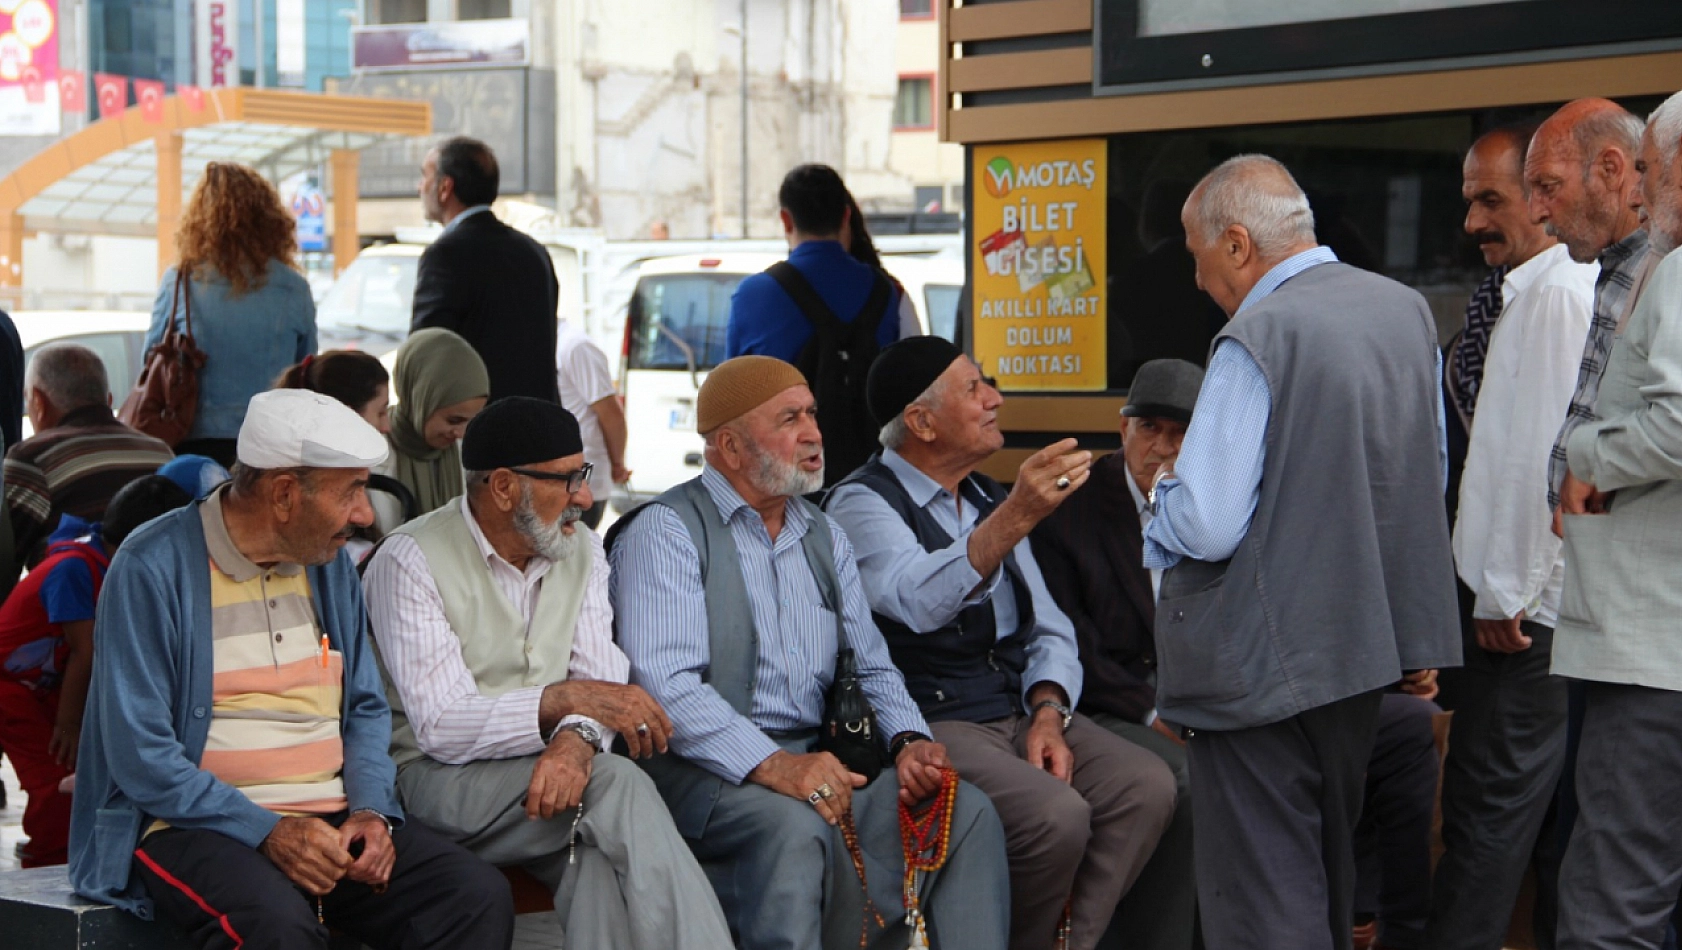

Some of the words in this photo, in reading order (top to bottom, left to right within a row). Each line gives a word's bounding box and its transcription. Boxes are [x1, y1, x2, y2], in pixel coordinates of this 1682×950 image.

[1016, 159, 1095, 190] MOTAŞ
[1003, 197, 1077, 233] BİLET
[981, 298, 1042, 318] AKILLI
[1047, 296, 1099, 316] KART
[1006, 326, 1072, 347] DOLUM
[998, 355, 1082, 375] NOKTASI
